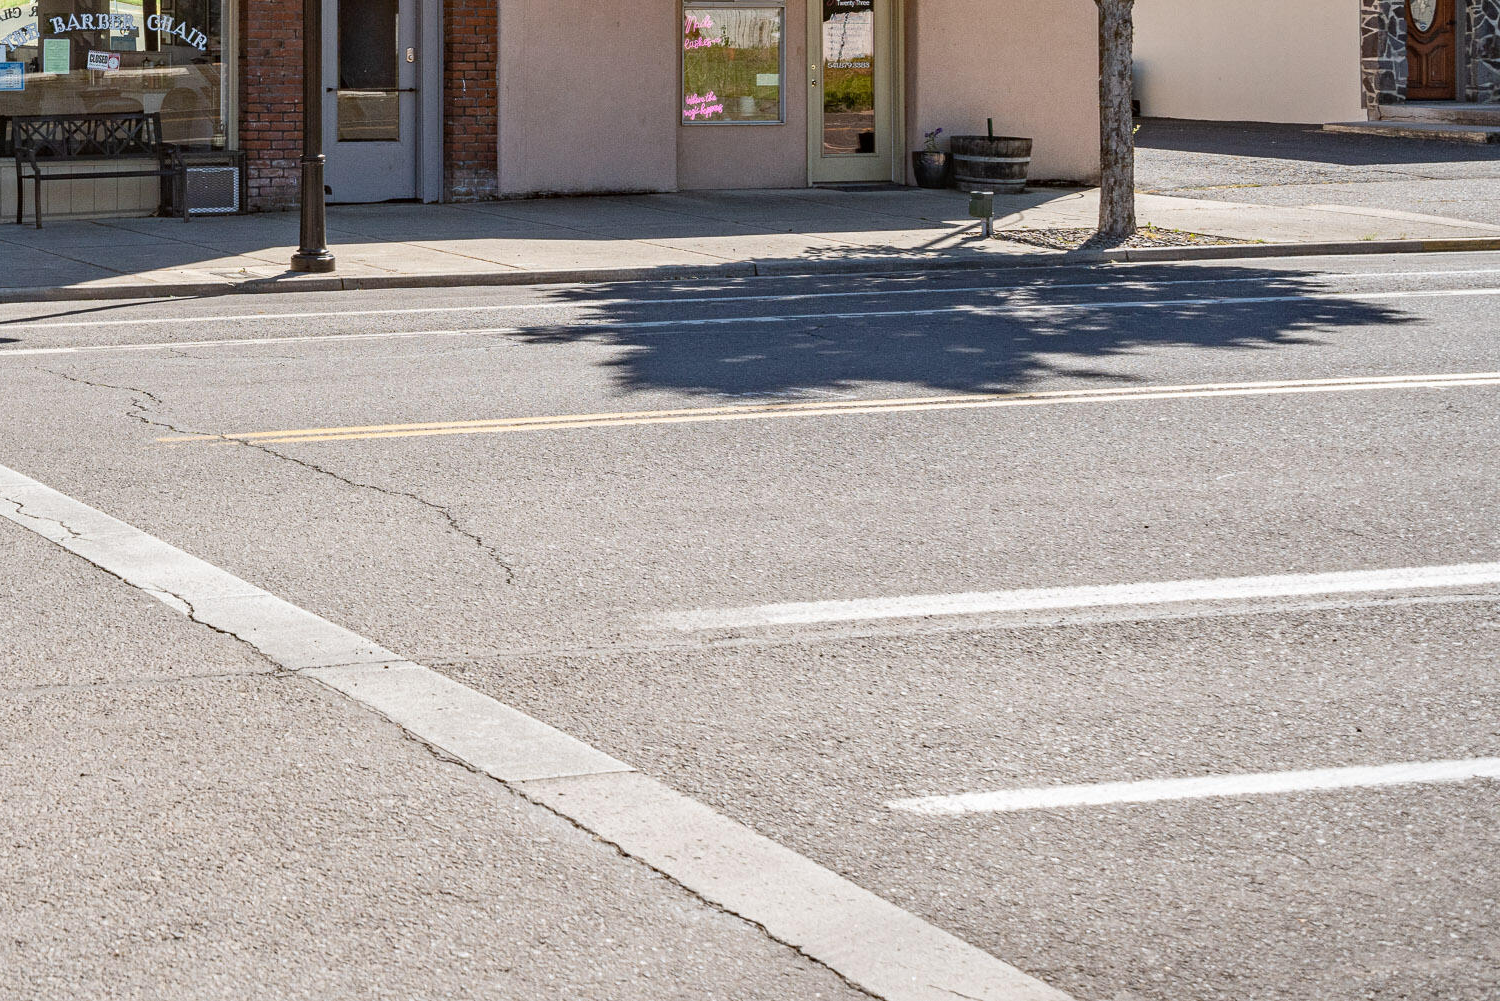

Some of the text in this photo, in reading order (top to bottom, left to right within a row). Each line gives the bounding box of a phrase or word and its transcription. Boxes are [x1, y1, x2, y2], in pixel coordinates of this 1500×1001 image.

[1, 13, 208, 52] THE BARBER CHAIR
[90, 54, 108, 65] CLOSED
